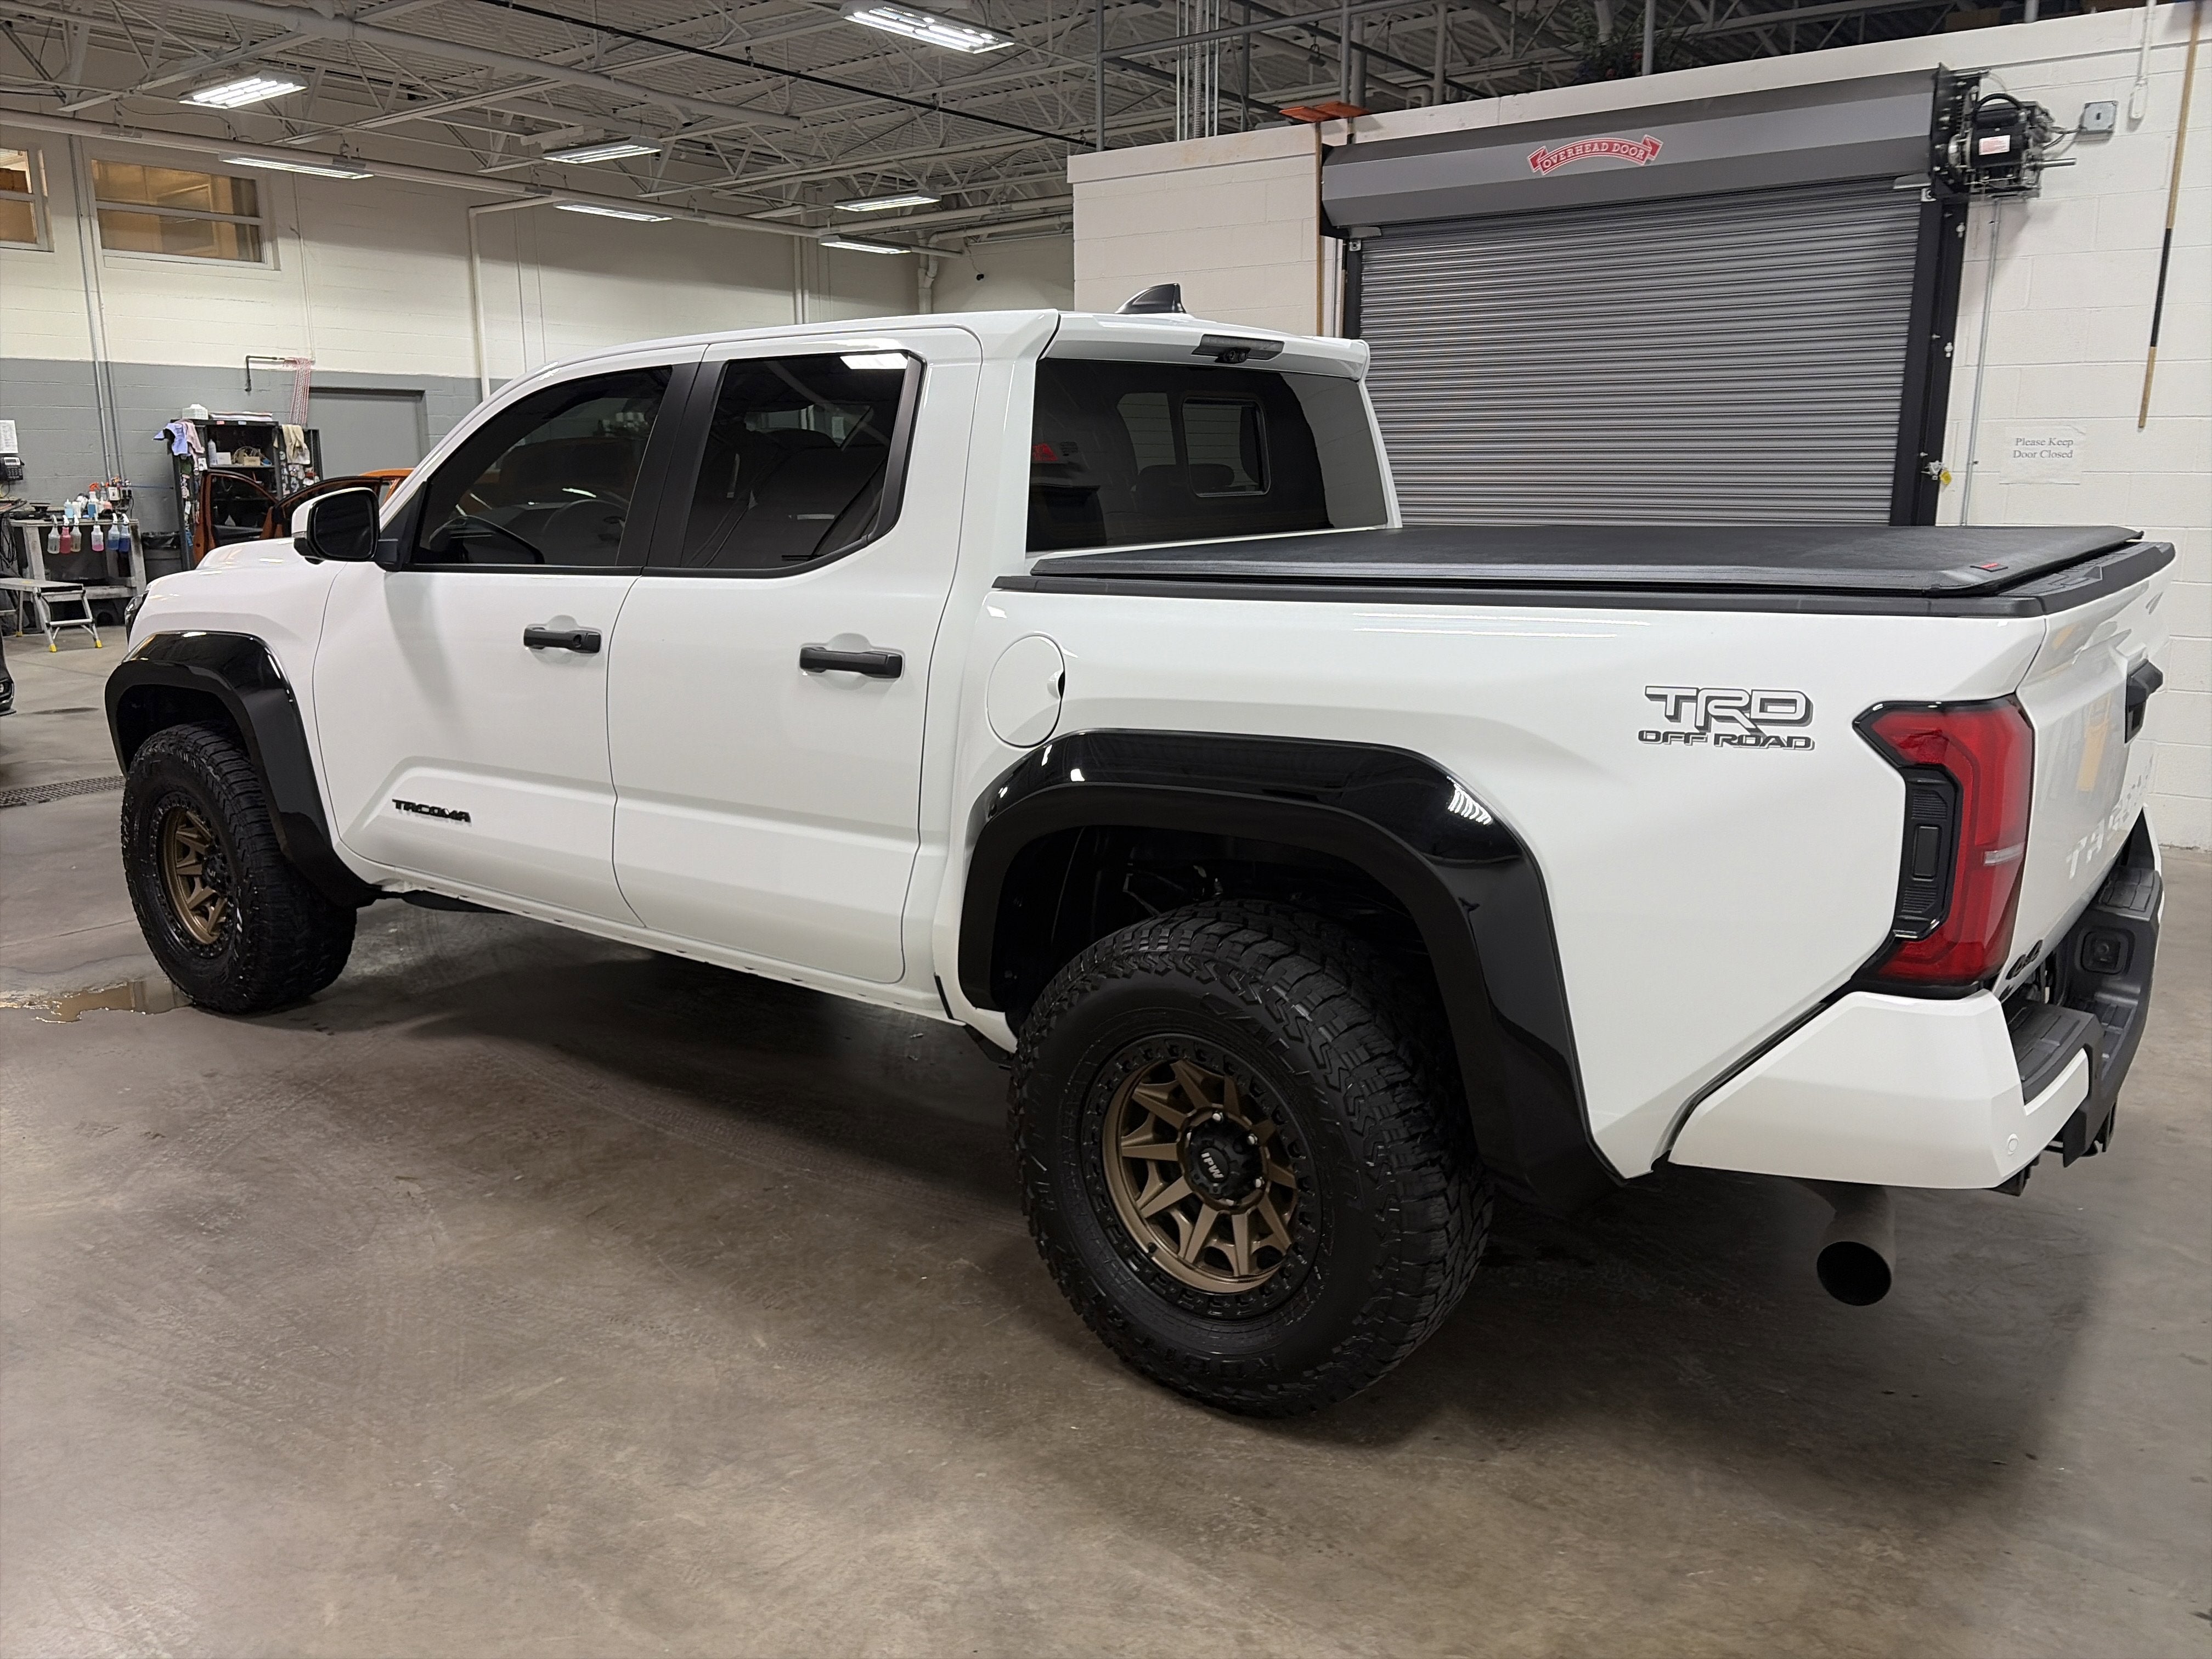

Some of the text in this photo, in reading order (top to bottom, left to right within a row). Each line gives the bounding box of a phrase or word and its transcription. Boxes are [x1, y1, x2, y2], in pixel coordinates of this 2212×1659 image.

[1542, 142, 1645, 168] OVERHEAD DOOR
[2013, 450, 2073, 458] Door Closed
[2015, 437, 2074, 448] Please Keep
[1645, 685, 1814, 733] TRD
[1638, 730, 1815, 751] OFF ROAD
[392, 798, 472, 823] TACOMA
